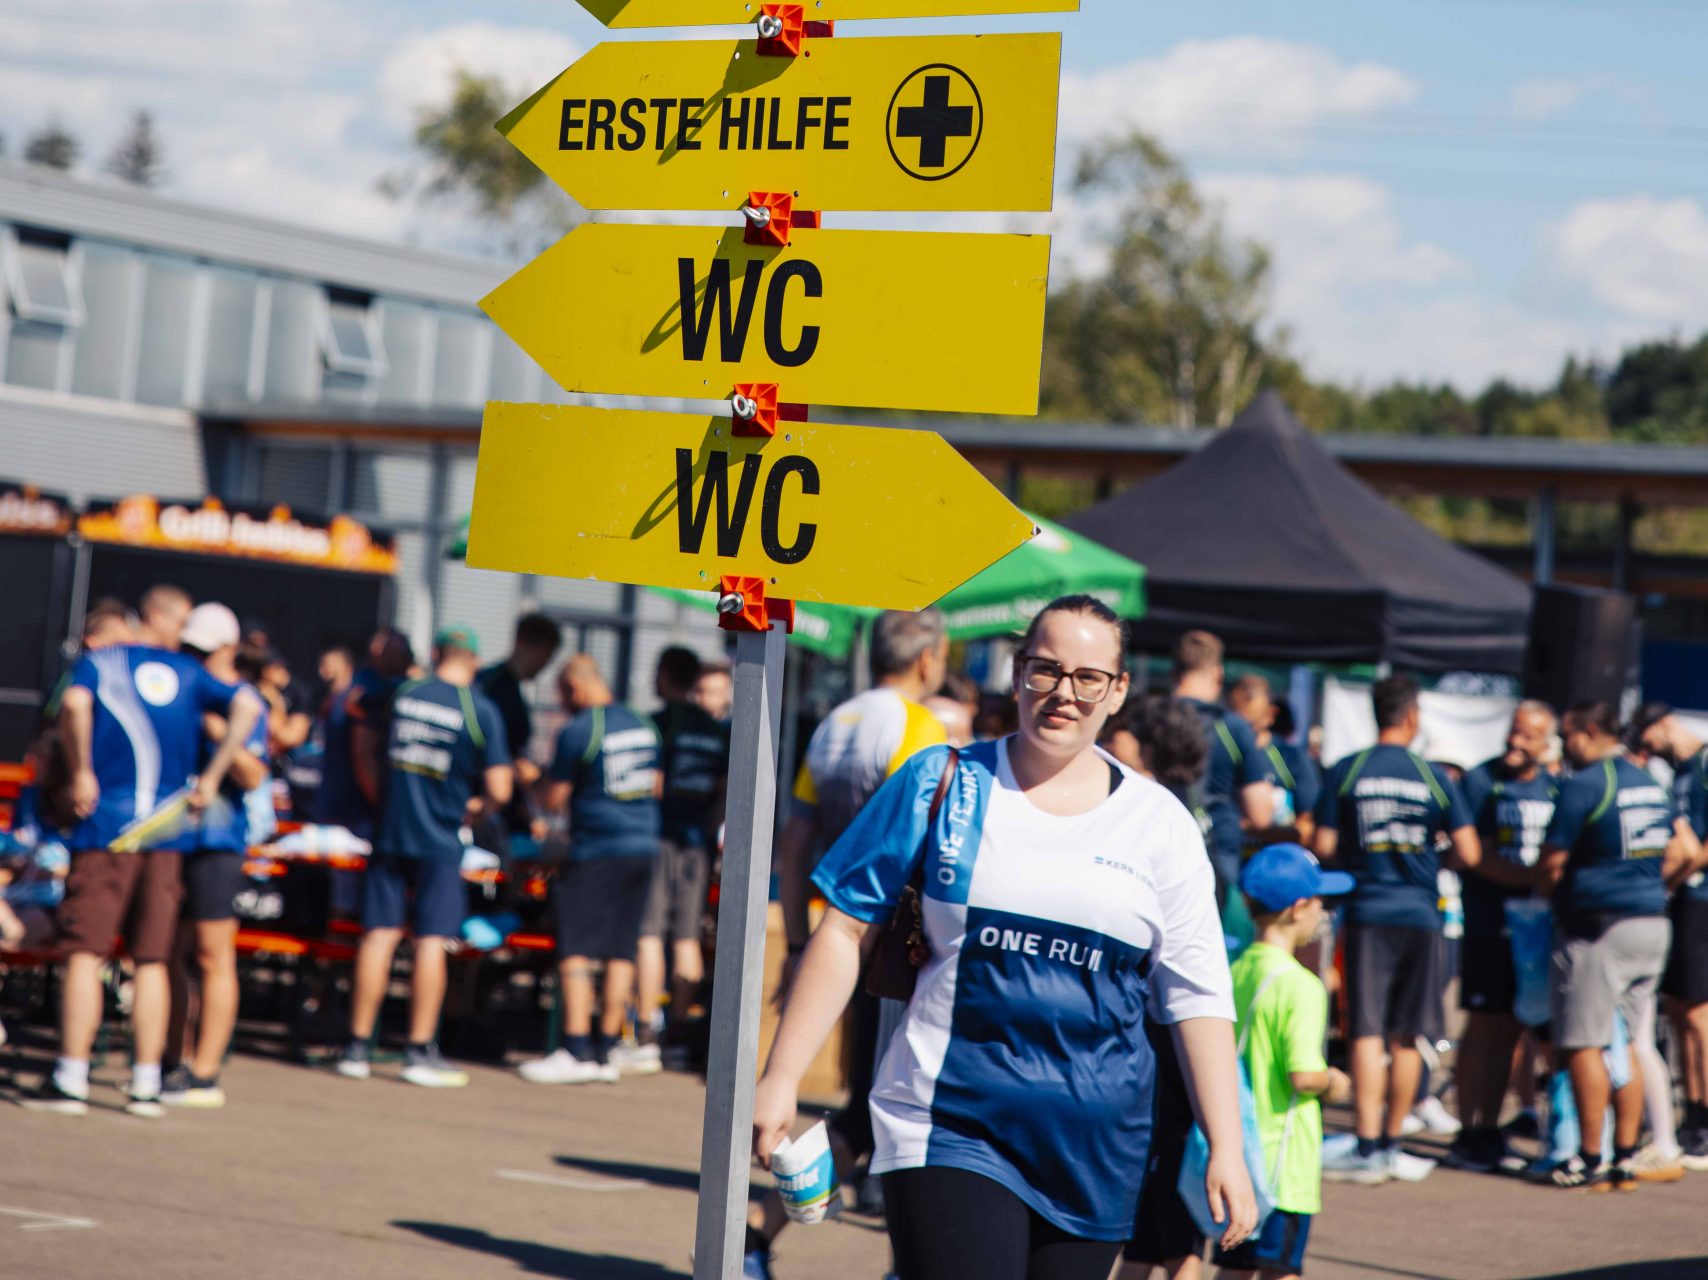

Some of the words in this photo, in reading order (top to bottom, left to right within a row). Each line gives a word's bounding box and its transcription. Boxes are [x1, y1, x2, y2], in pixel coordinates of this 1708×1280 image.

[559, 99, 704, 150] ERSTE
[719, 97, 852, 150] HILFE
[678, 258, 822, 367] WC
[675, 448, 820, 564] WC
[938, 832, 964, 885] ONE
[980, 926, 1042, 956] ONE
[1048, 938, 1103, 972] RUN
